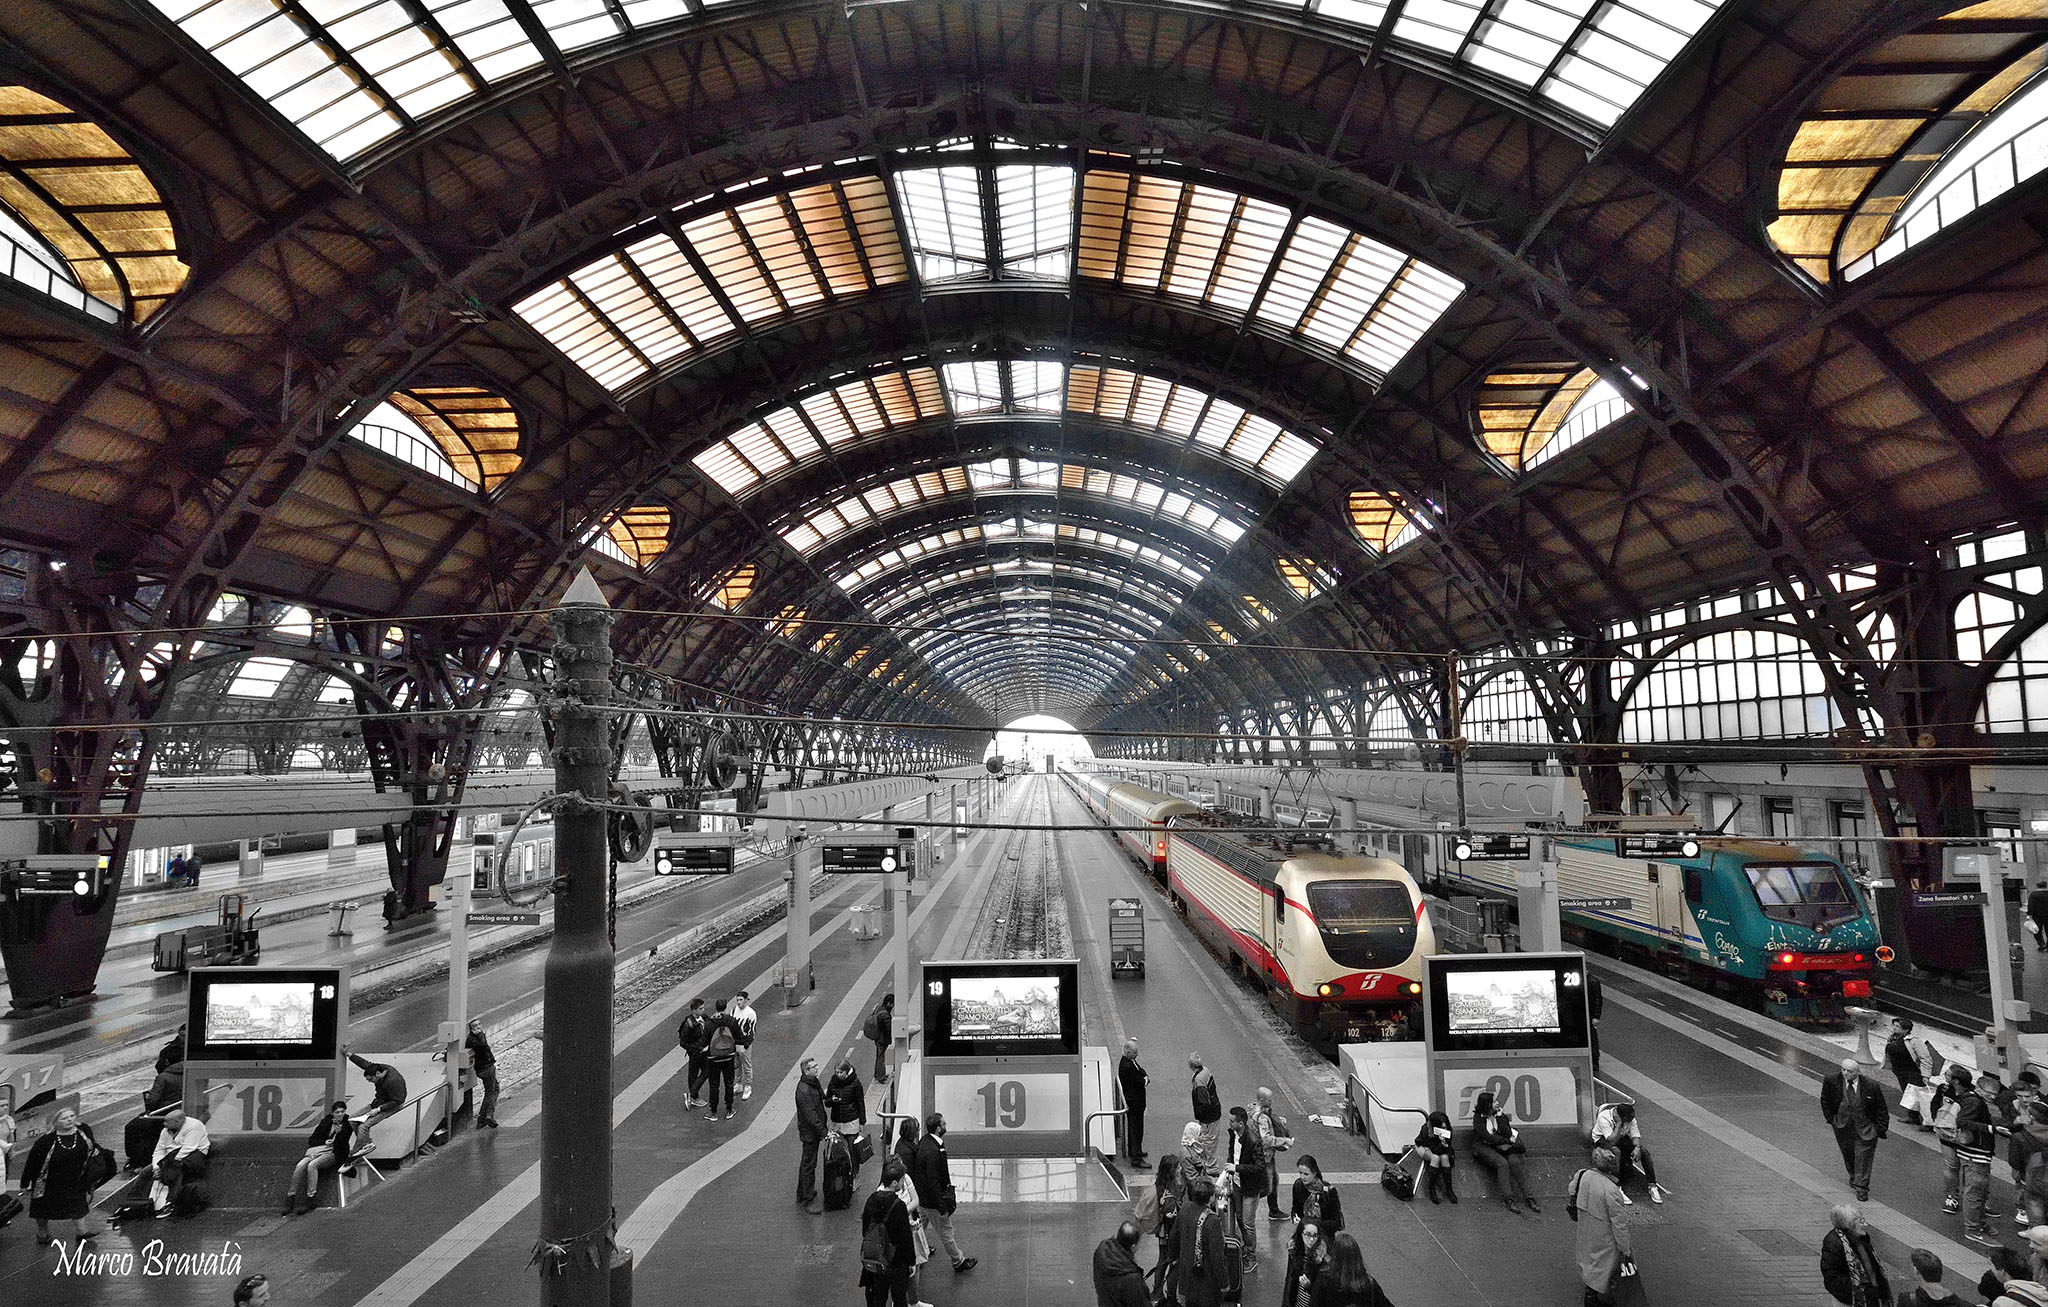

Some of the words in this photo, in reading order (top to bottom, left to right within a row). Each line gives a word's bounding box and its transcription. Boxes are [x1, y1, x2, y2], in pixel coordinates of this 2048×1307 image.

[928, 981, 944, 996] 19
[1563, 972, 1580, 987] 20
[319, 985, 335, 999] 18
[1347, 1028, 1360, 1038] 102
[22, 1064, 56, 1090] 17
[236, 1085, 283, 1131] 18
[977, 1081, 1026, 1128] 19
[1485, 1074, 1541, 1122] 20
